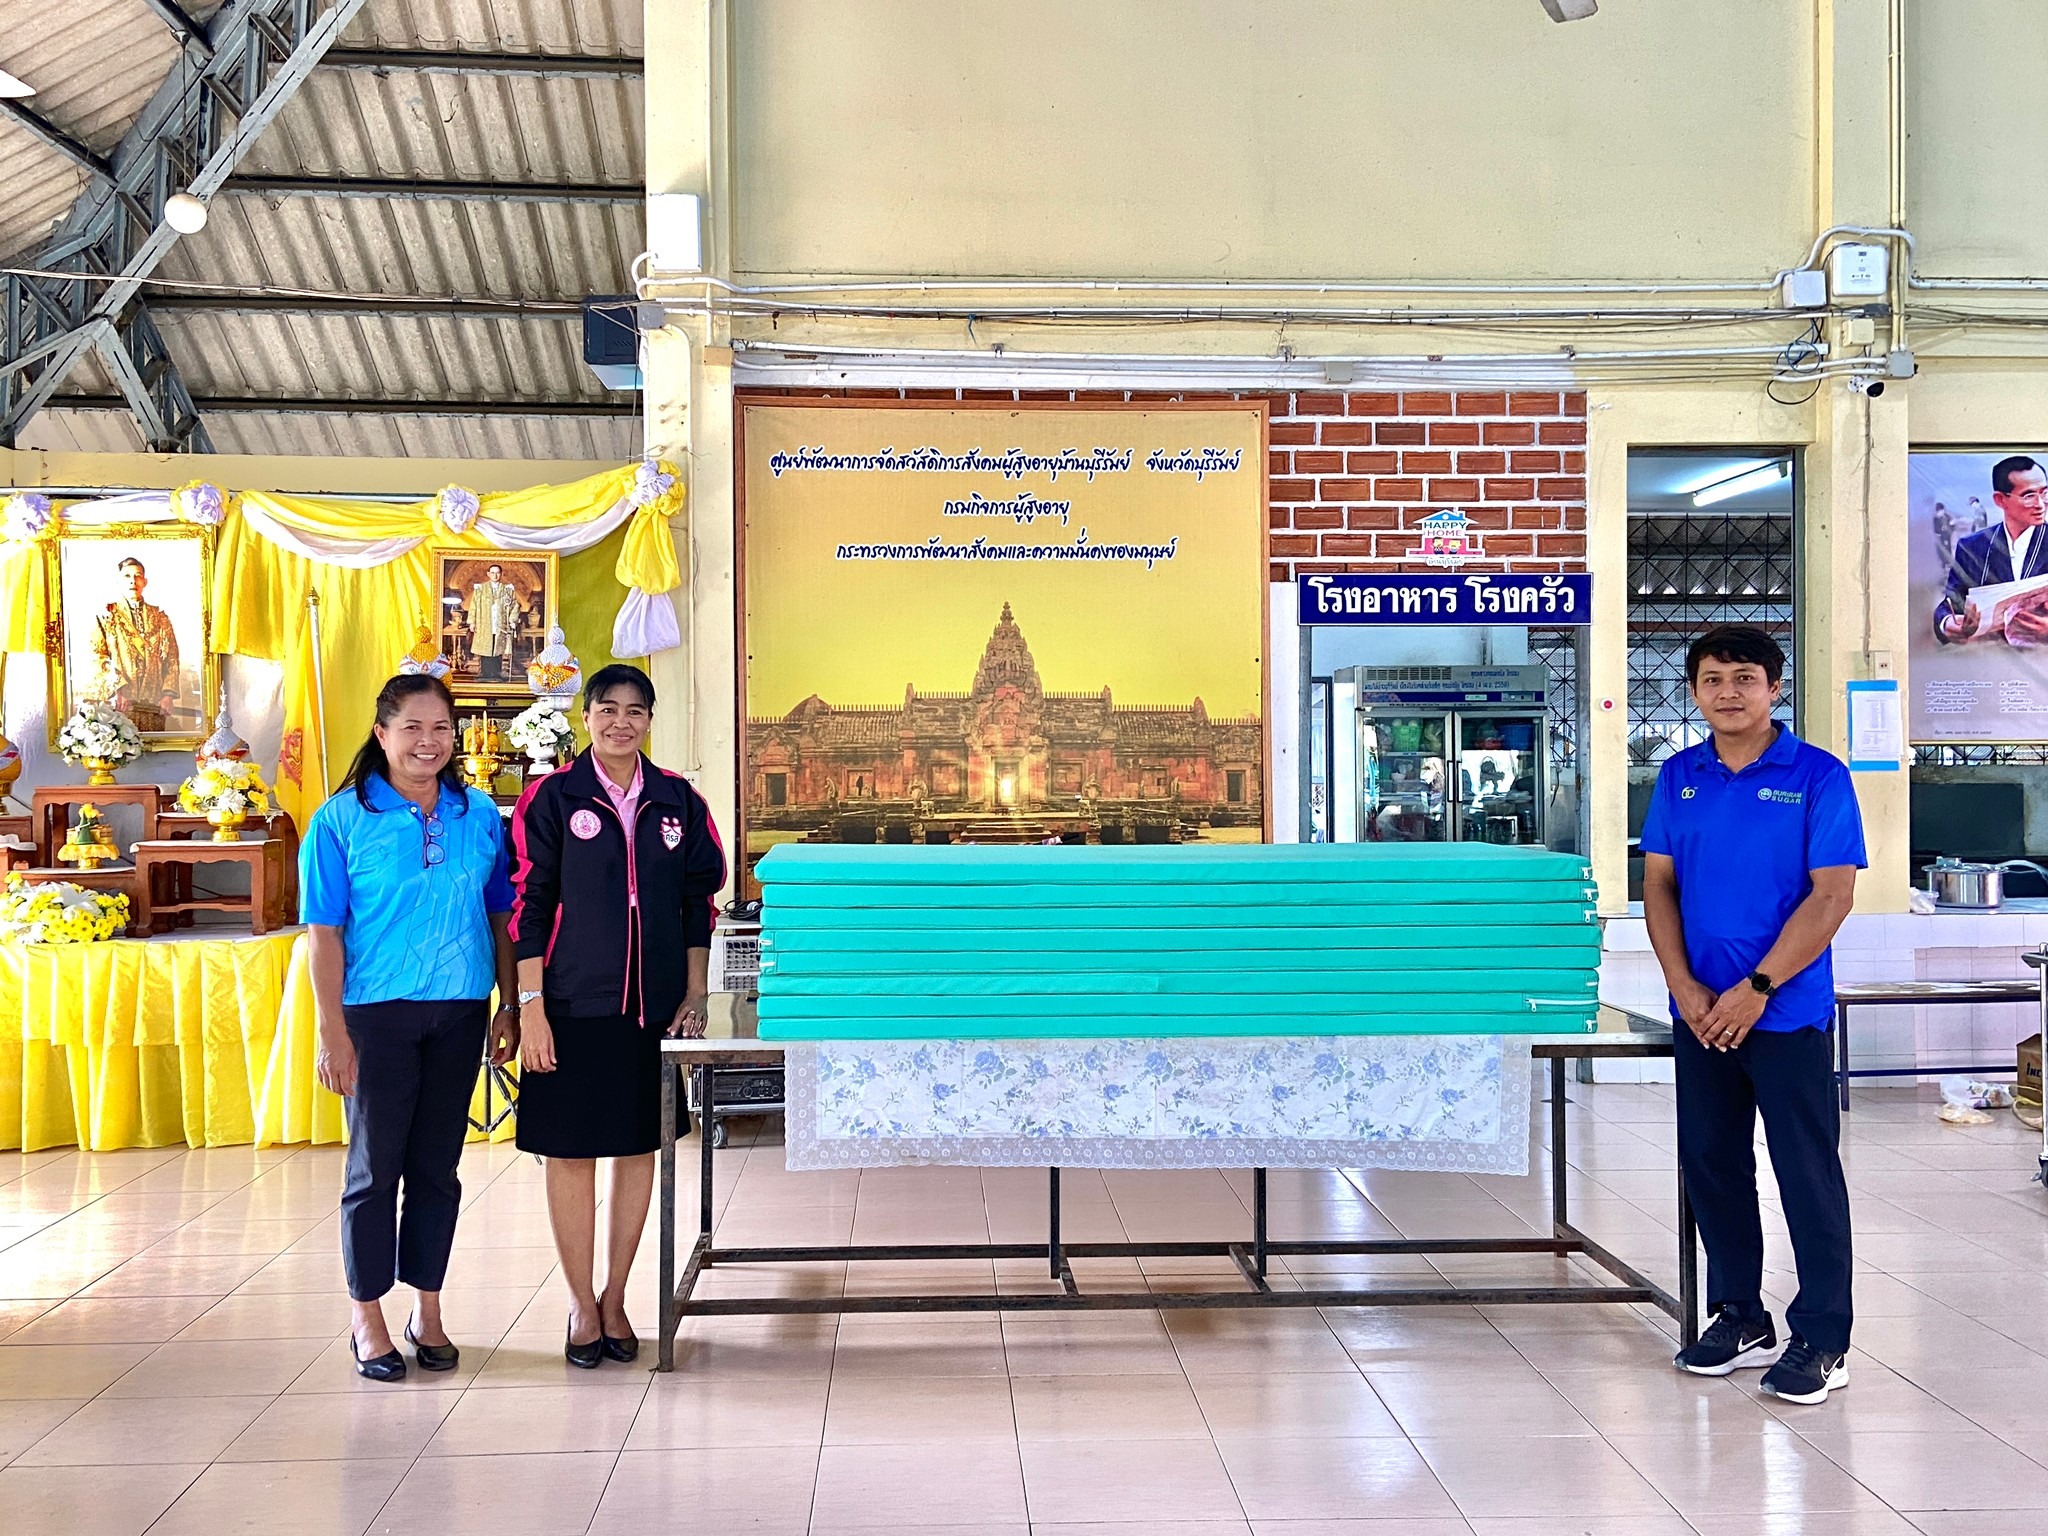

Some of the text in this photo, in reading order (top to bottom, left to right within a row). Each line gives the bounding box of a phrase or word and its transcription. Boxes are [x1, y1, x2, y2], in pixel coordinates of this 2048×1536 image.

[769, 447, 1242, 481] ศูนย์พัฒนาการจัดสวัสดิการสังคมผู้สูงอายุบ้านบุรีรัมย์ จังหวัดบุรีรัมย์
[943, 492, 1071, 524] กรมกิจการผู้สูงอายุ
[836, 527, 1177, 569] กระทรวงการพัฒนาสังคมและความมั่นคงของมนุษย์
[1307, 575, 1576, 614] โรงอาหาร โรงครัว
[1771, 795, 1802, 805] SUGAR
